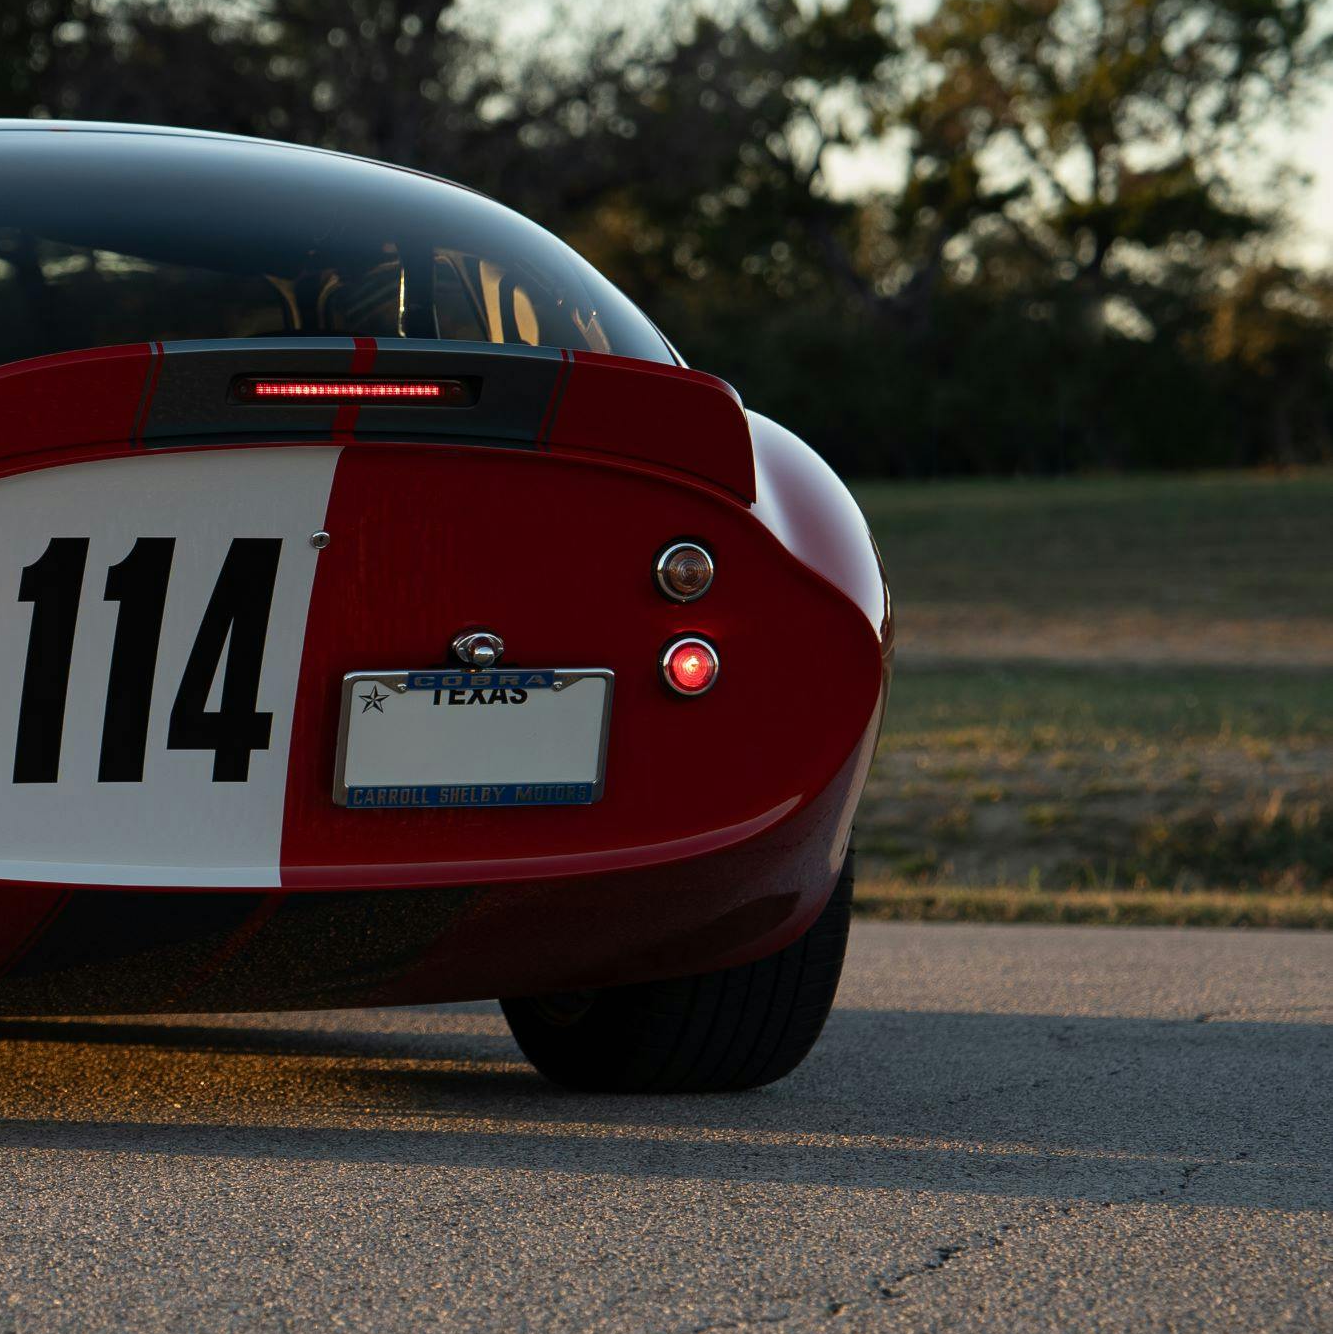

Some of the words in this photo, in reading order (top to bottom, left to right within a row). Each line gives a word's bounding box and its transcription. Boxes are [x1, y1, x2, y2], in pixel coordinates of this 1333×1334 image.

[12, 537, 284, 784] 114
[413, 674, 547, 687] COBRA
[433, 688, 528, 705] TEXAS
[352, 788, 430, 805] CARROLL
[439, 786, 506, 803] SHELBY
[515, 784, 587, 803] MOTORS
